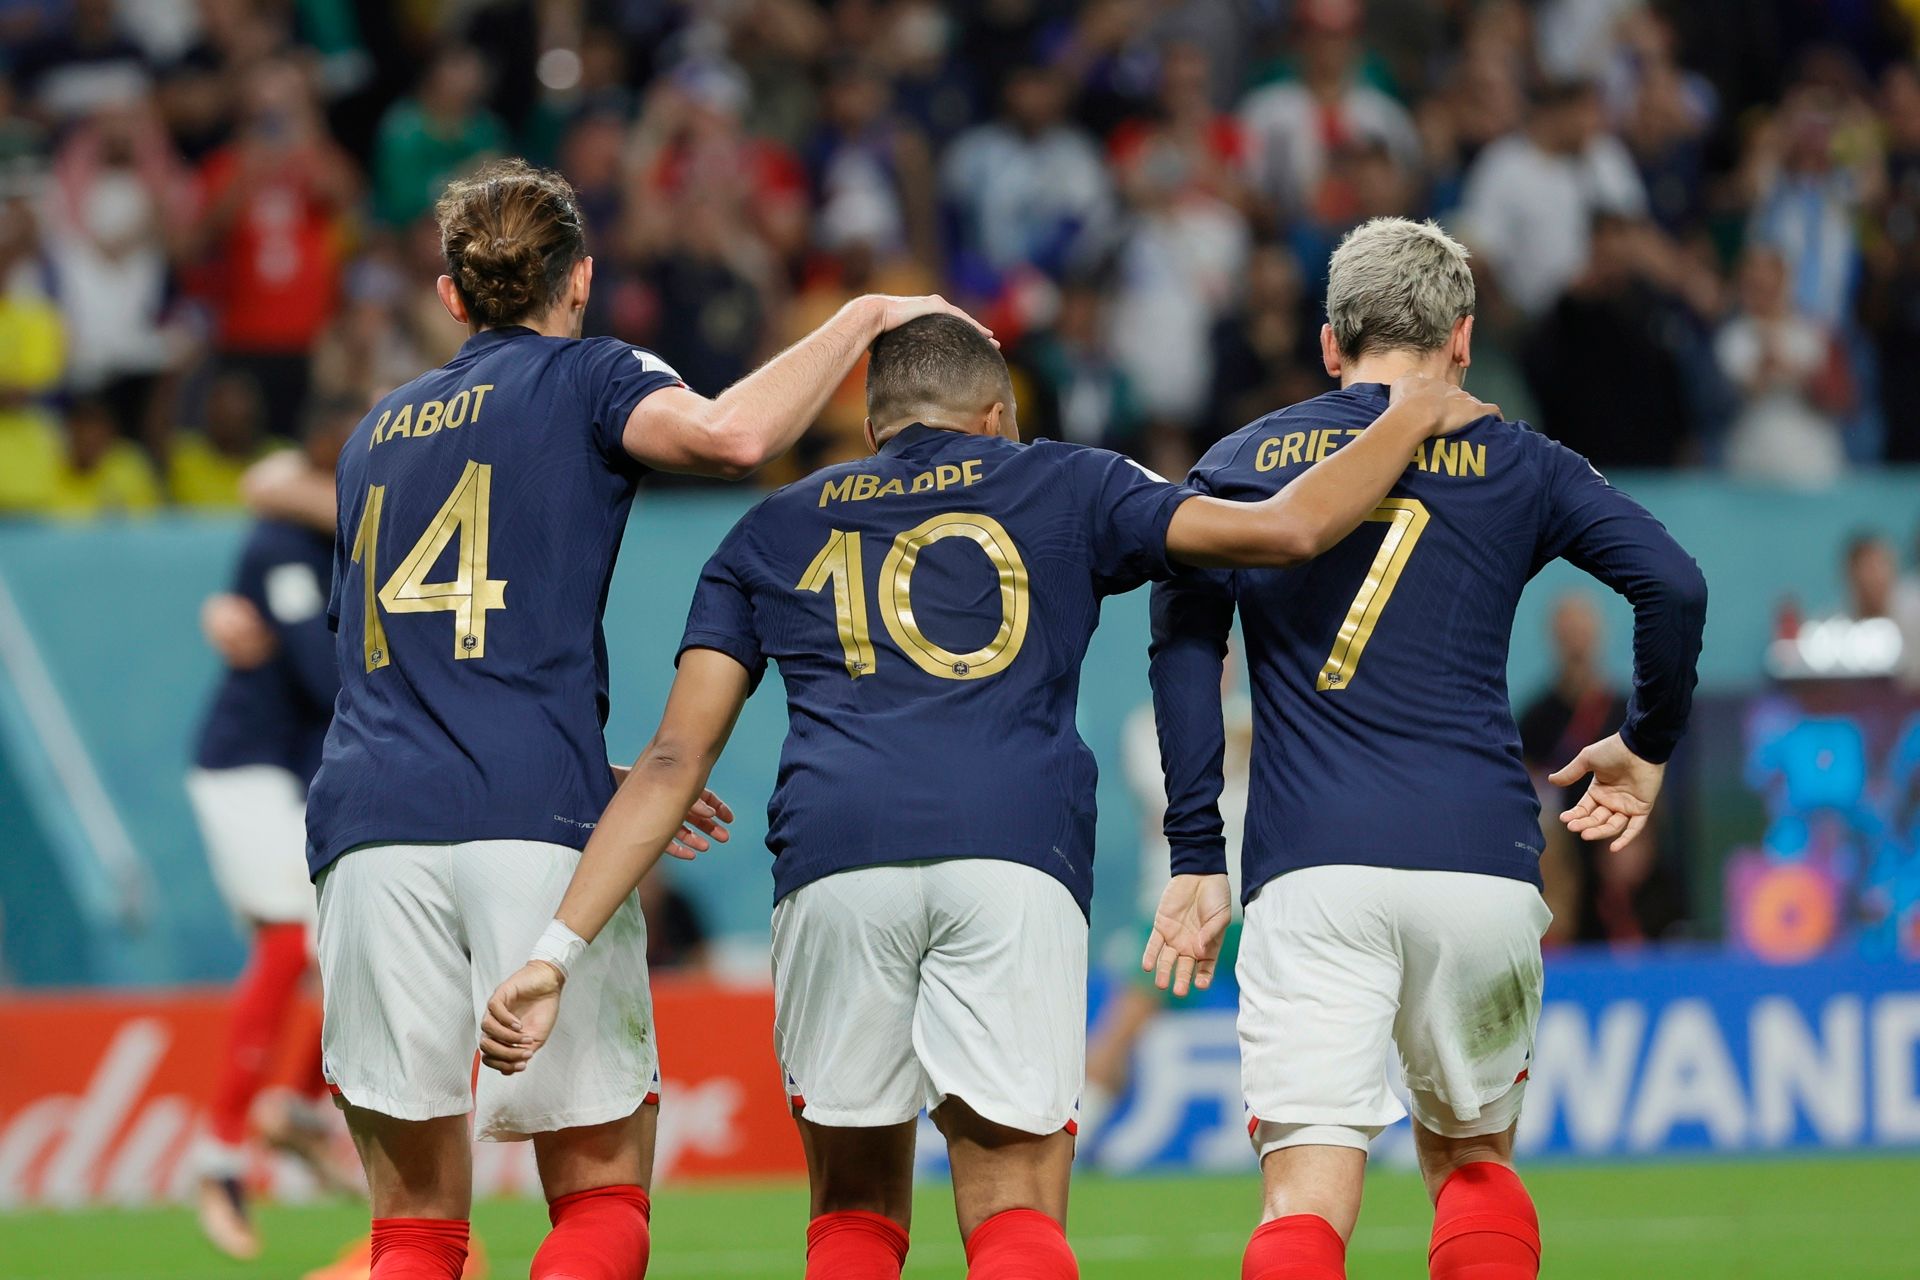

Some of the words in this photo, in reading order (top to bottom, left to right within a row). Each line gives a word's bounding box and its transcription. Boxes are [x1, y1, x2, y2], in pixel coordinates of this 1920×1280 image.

[369, 384, 494, 451] RABIOT
[1255, 429, 1487, 477] GRIEANN
[819, 459, 983, 508] MBAPPE
[352, 459, 508, 674] 14
[795, 512, 1030, 680] 10
[1316, 498, 1432, 692] 7
